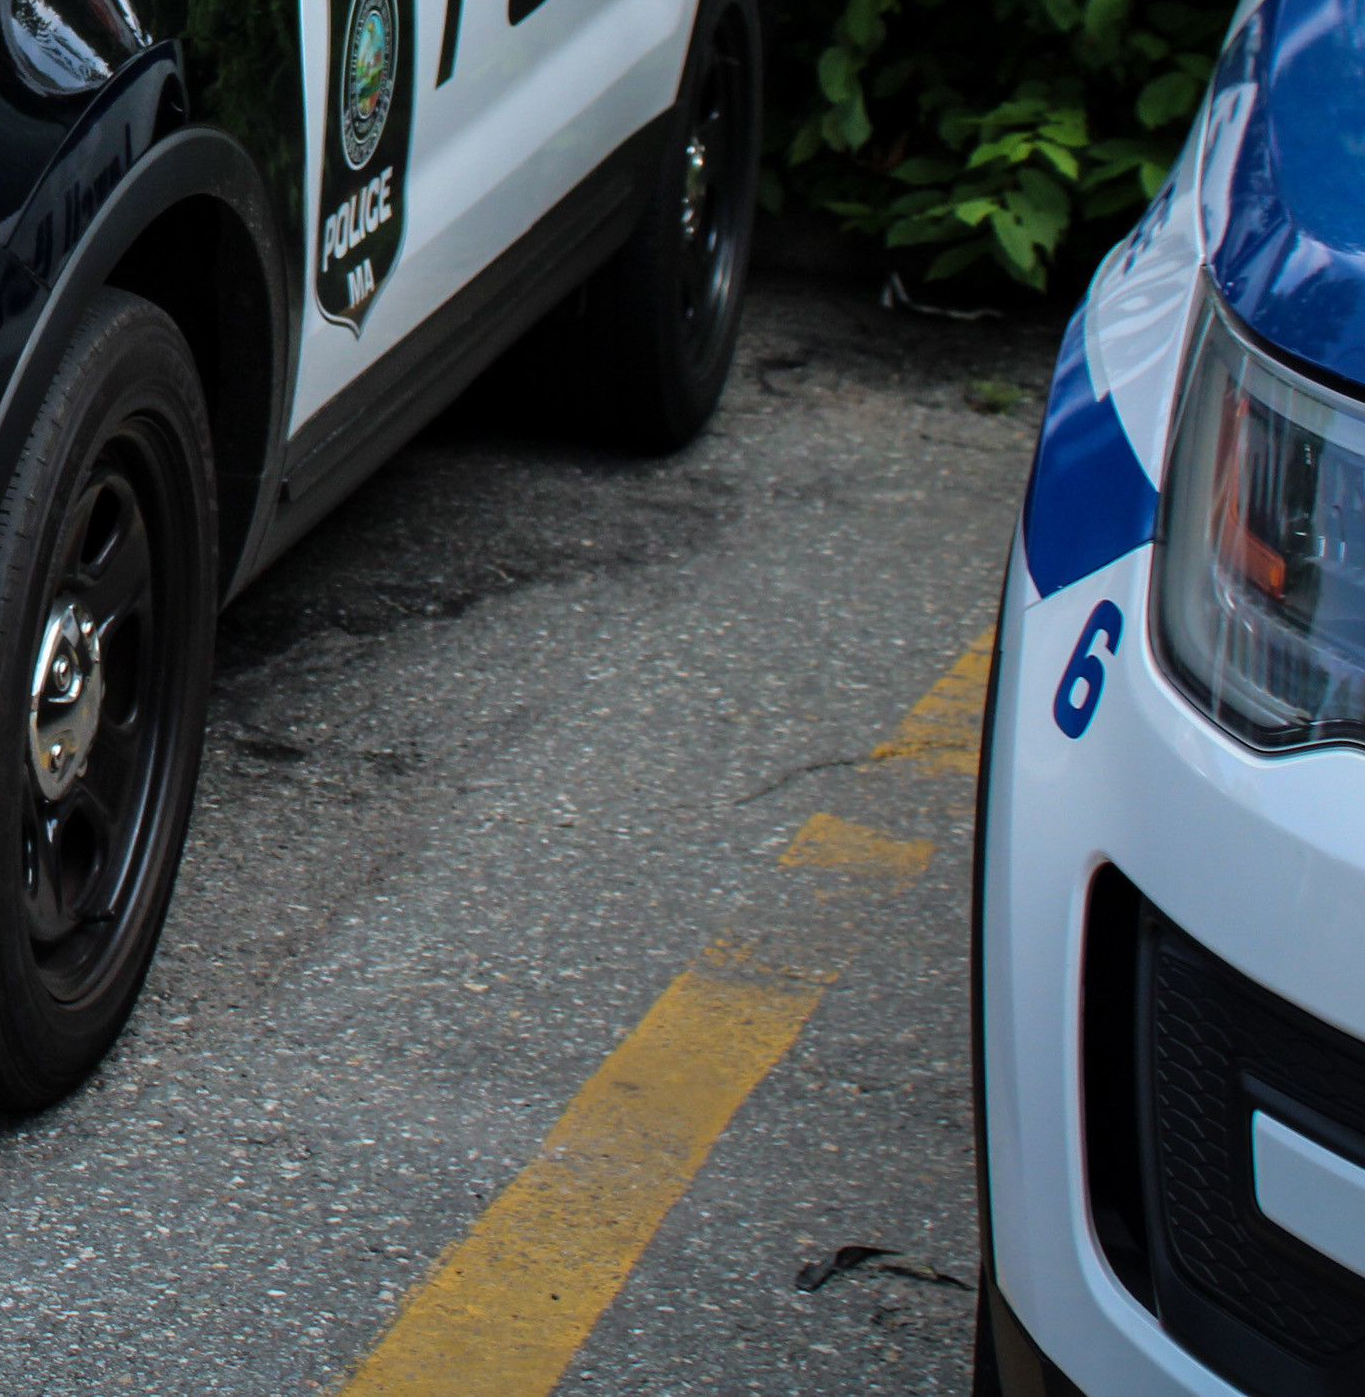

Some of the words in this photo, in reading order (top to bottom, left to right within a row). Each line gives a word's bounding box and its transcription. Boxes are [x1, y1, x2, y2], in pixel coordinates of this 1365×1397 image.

[322, 166, 393, 273] POLICE
[347, 258, 376, 309] MA
[1052, 599, 1124, 740] 6
